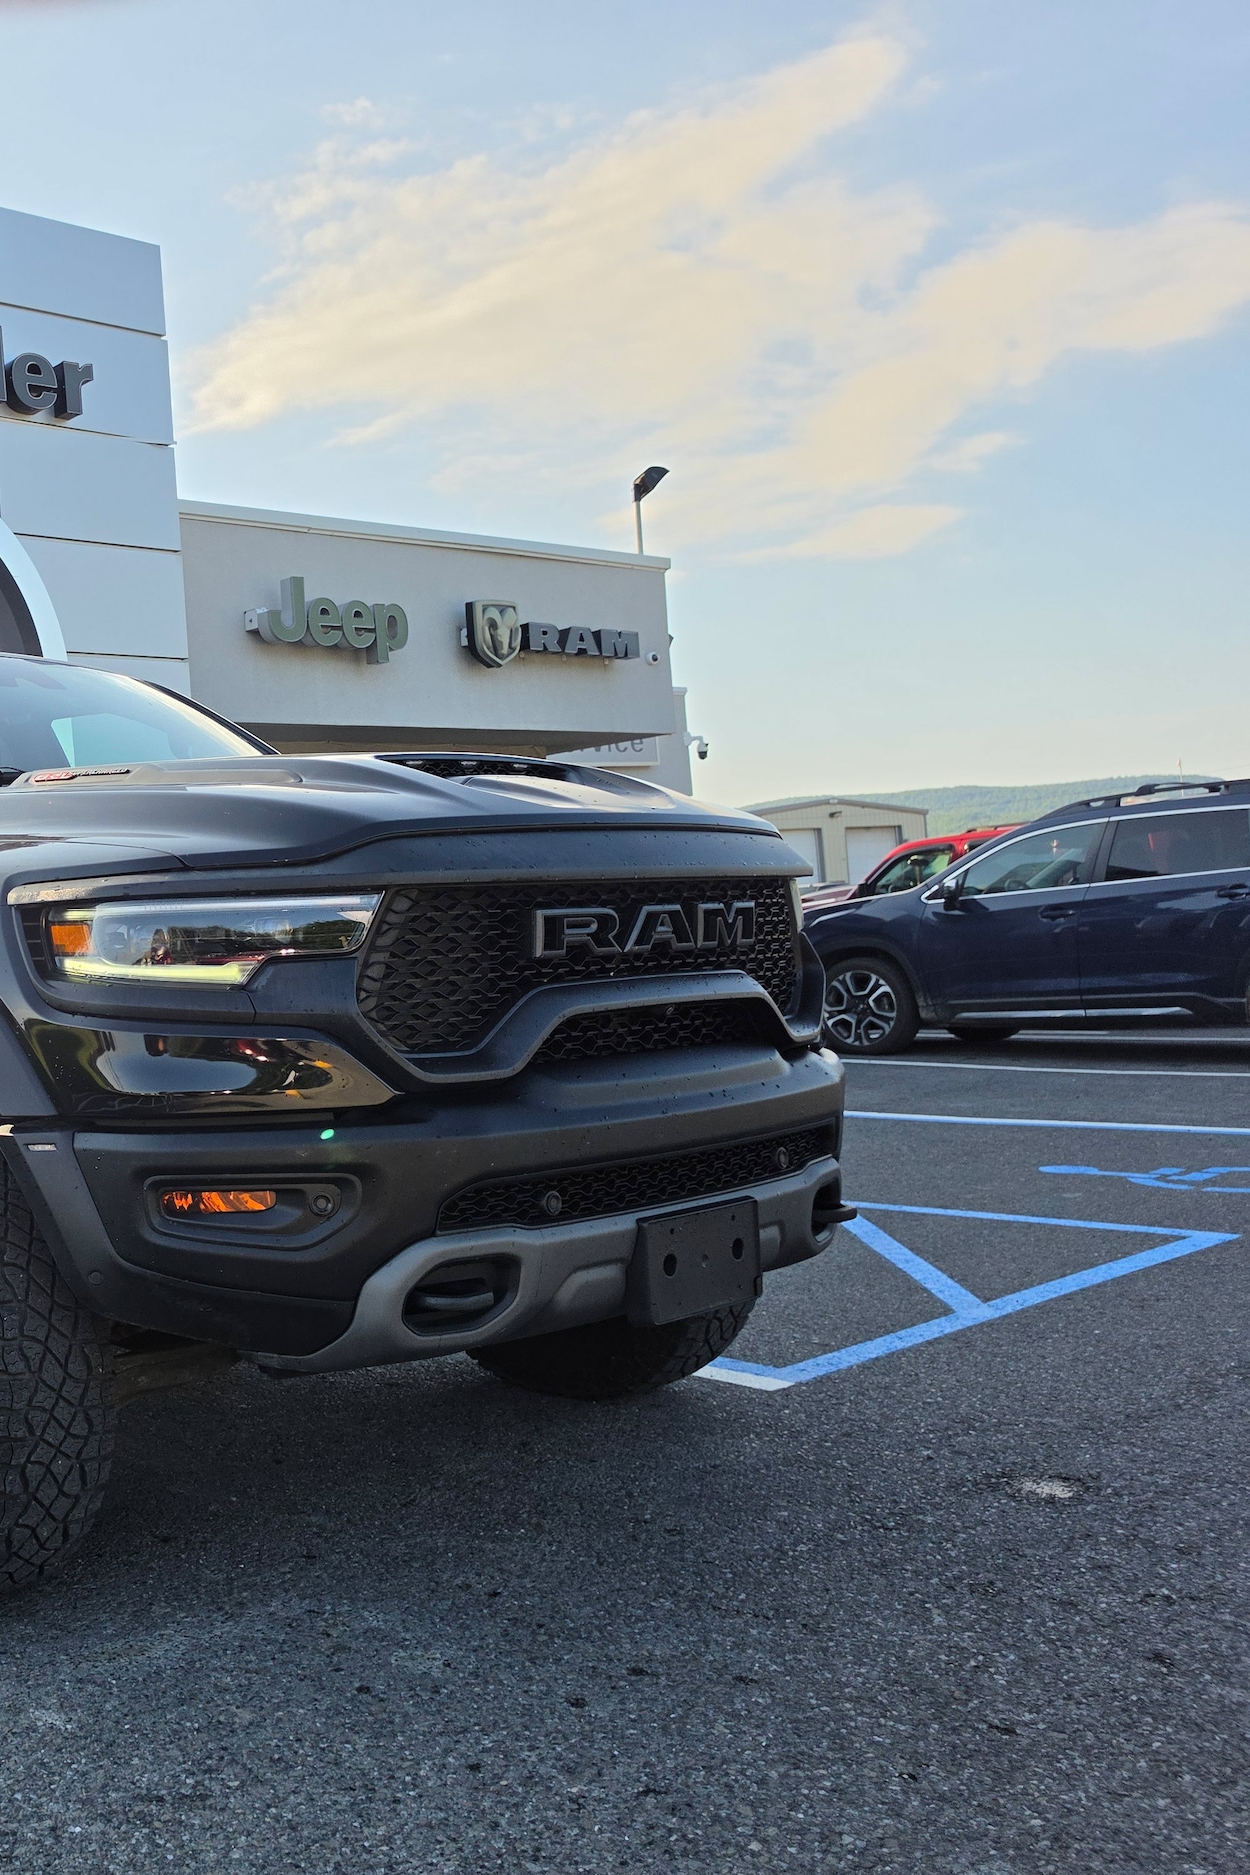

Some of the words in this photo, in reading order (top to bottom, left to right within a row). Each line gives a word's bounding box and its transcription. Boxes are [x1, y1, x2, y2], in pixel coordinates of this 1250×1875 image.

[256, 575, 409, 666] Jeep
[521, 621, 641, 661] RAM
[534, 900, 757, 959] RAM
